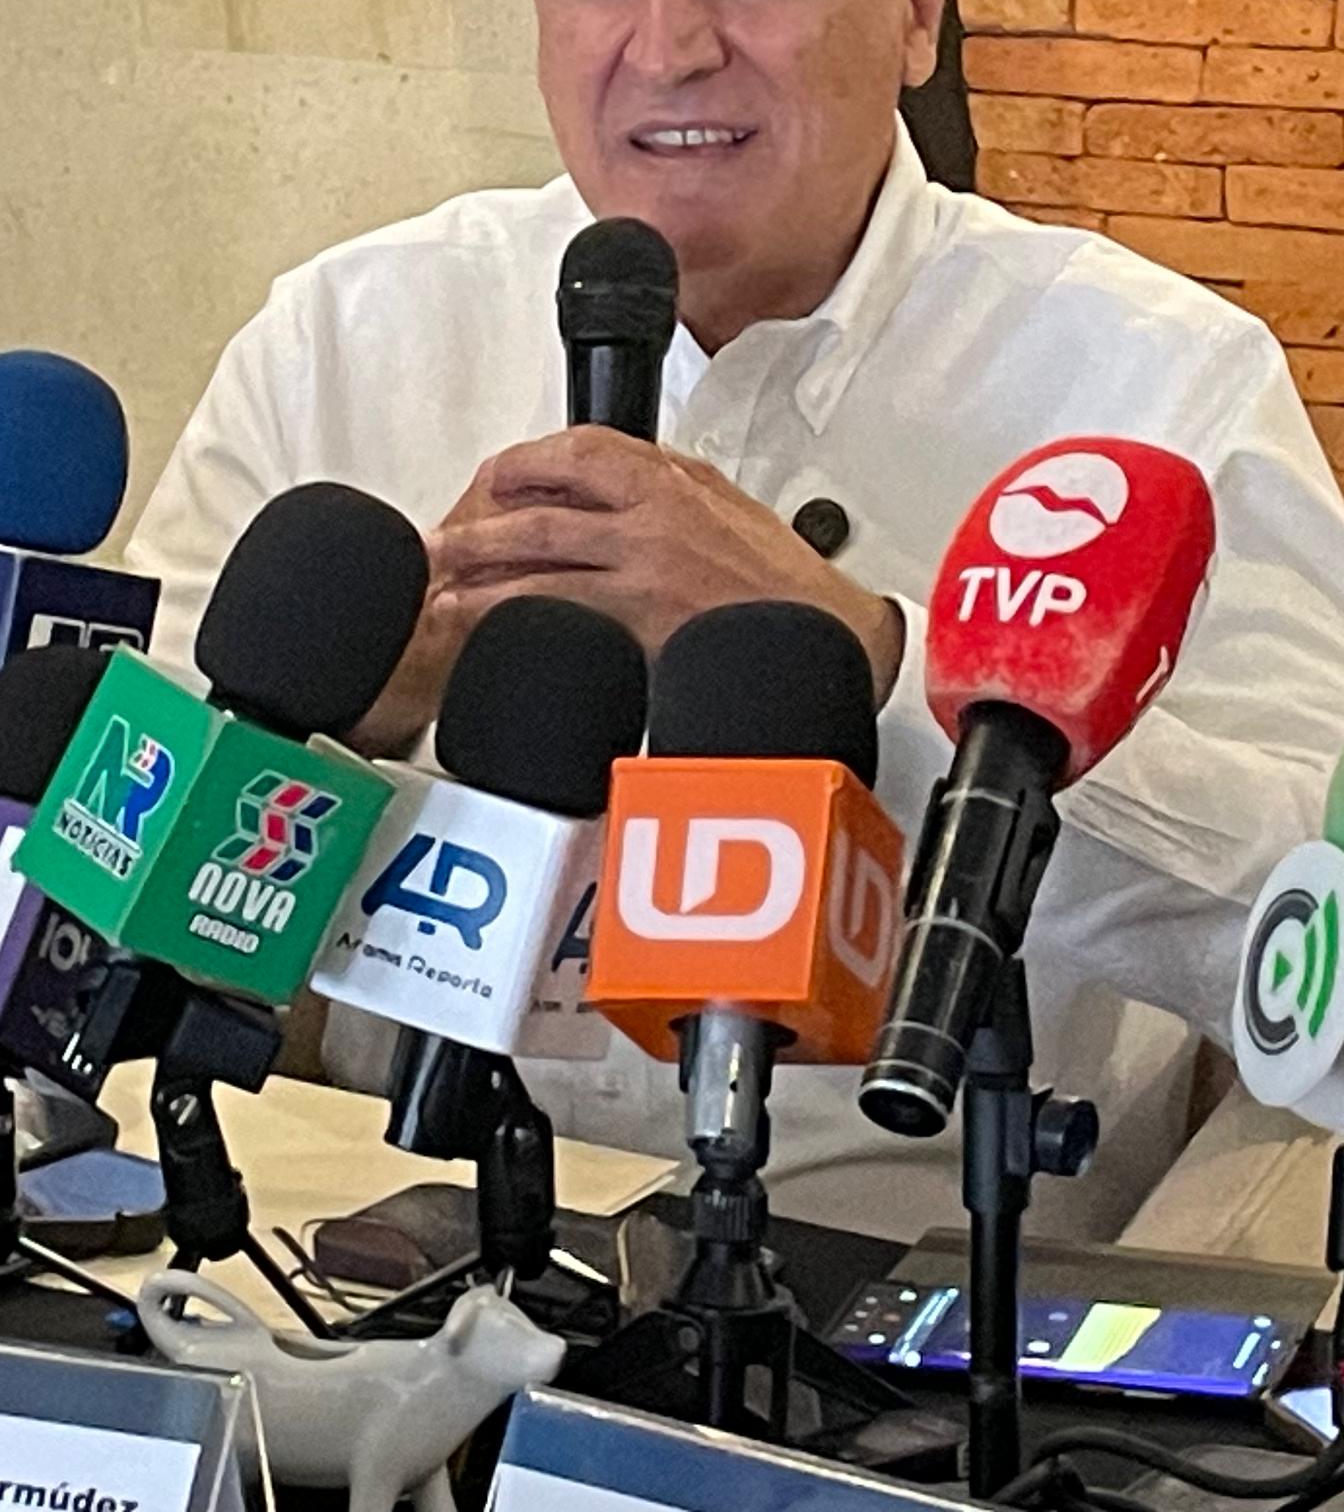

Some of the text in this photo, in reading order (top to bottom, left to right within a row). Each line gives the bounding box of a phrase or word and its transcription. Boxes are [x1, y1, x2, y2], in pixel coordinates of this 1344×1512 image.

[958, 567, 1088, 627] TVP
[59, 813, 134, 877] NOTICIAS
[188, 862, 296, 933] NOVA
[188, 914, 260, 954] RADIO
